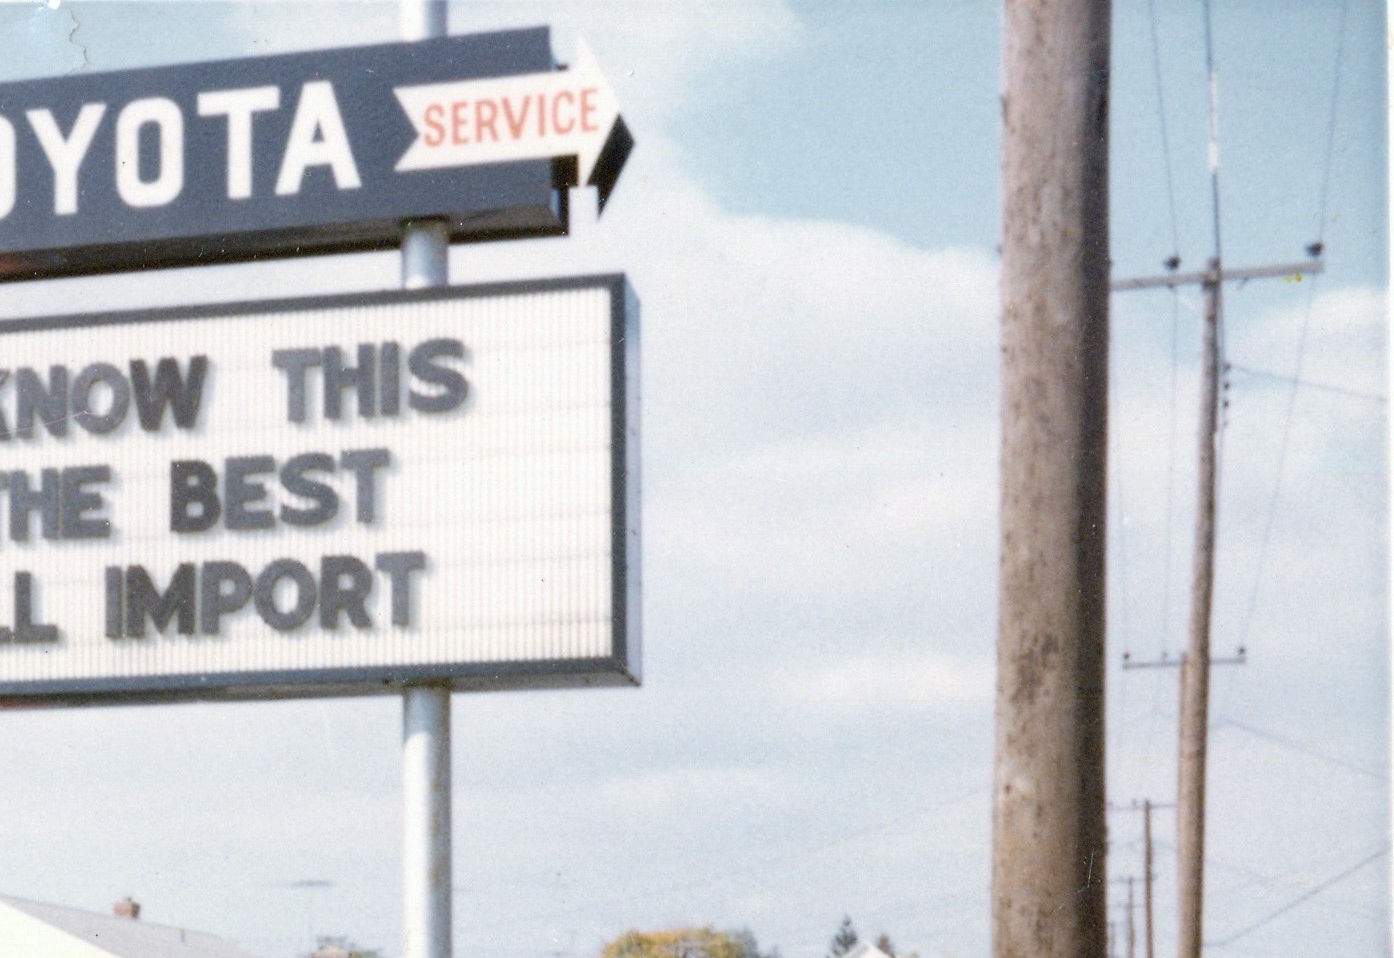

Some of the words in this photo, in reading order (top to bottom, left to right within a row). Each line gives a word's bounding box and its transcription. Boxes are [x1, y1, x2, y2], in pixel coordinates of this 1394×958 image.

[422, 89, 599, 148] SERVICE
[272, 338, 471, 424] THIS
[169, 448, 391, 535] BEST
[105, 550, 427, 640] IMPORT
